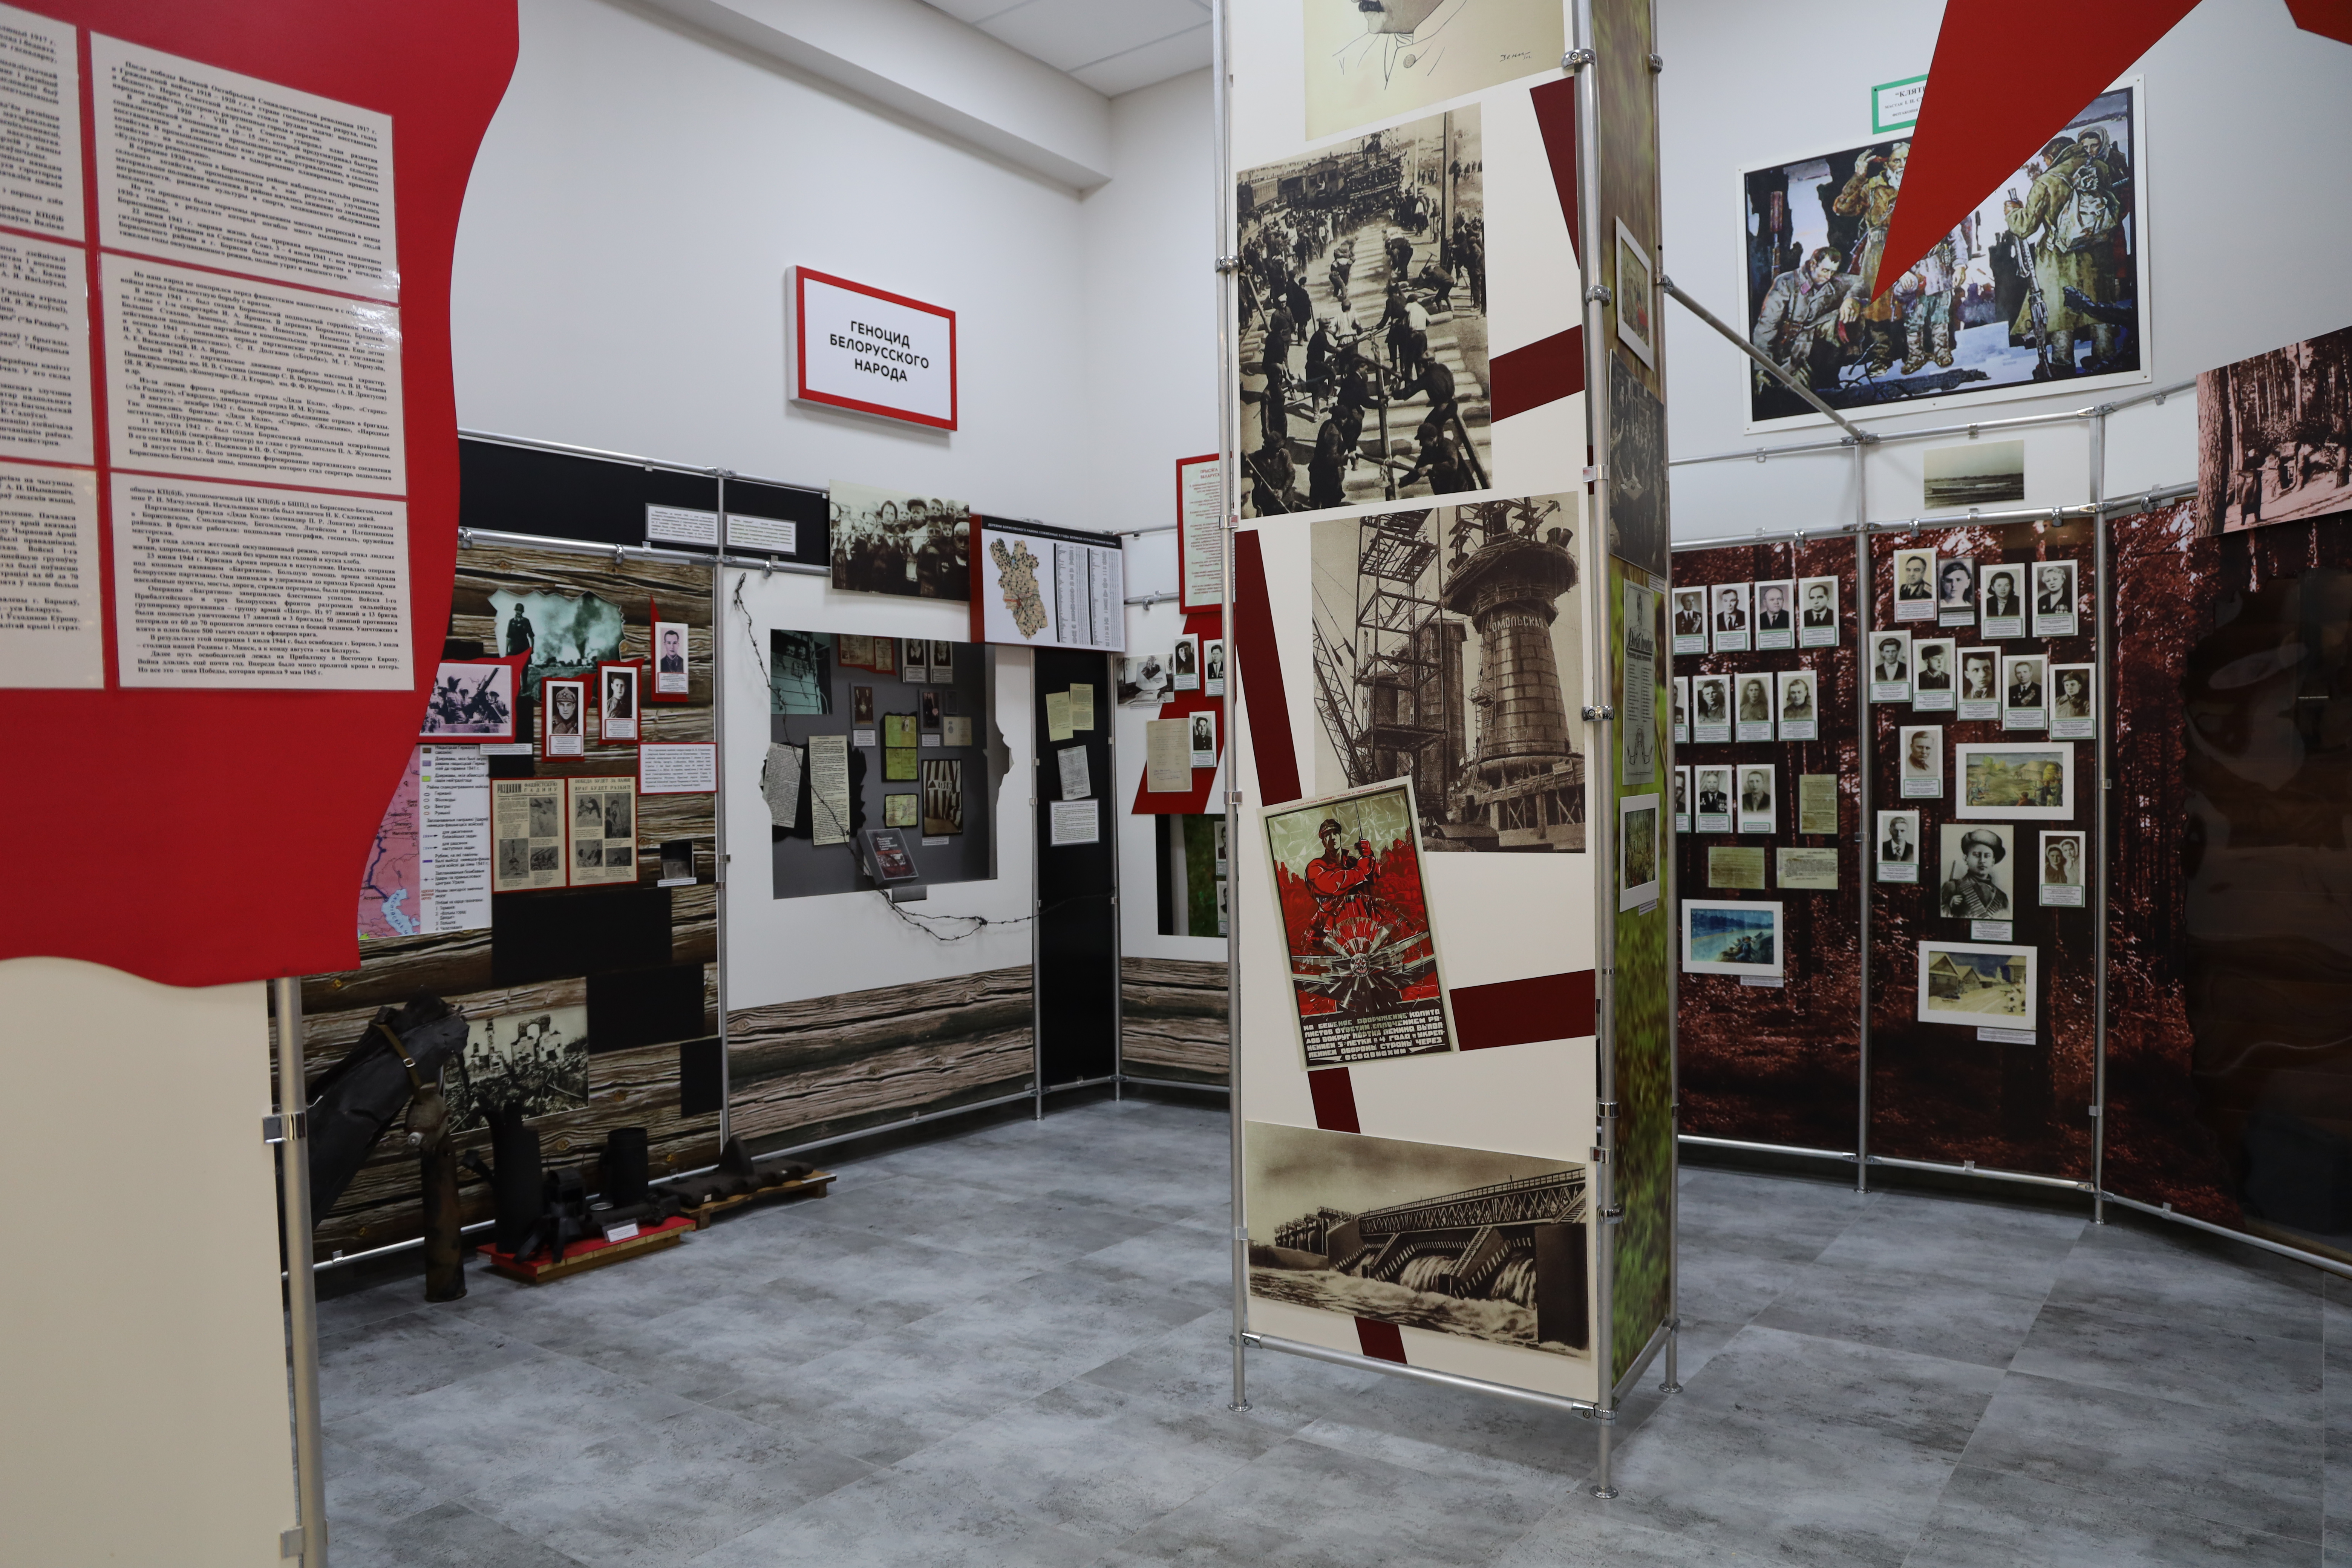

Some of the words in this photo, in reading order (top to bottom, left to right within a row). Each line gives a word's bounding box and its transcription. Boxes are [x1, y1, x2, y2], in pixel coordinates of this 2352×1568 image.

[125, 61, 147, 72] После
[150, 70, 176, 80] победы
[179, 76, 208, 89] Великой
[211, 86, 255, 101] Октябрьской
[258, 98, 317, 118] Социалистической
[320, 116, 354, 128] революции
[851, 320, 910, 349] ГЕНОЦИД
[830, 333, 929, 369] БЕЛОРУССКОГО
[854, 358, 907, 382] НАРОДА
[129, 449, 214, 462] Борисовско-Бегомльской
[185, 493, 243, 501] уполномоченный
[320, 504, 392, 515] Борисовско-Бегомльской
[1318, 1020, 1352, 1029] БЕШЕНОЕ
[1357, 1013, 1407, 1024] ВООРУЖЕНИЕ
[1409, 1009, 1440, 1018] КАПИТА
[1305, 1028, 1333, 1037] ЛИСТОВ
[1335, 1024, 1370, 1034] ОТВЕТИМ
[1322, 1033, 1351, 1042] ВОКРУГ
[1353, 1030, 1381, 1038] ПАРТИИ
[1383, 1026, 1415, 1035] ЛЕНИНА
[1307, 1042, 1335, 1050] НЕНИЕМ
[1309, 1049, 1337, 1057] ЛЕНИЕМ
[1341, 1044, 1377, 1054] ОБОРОНЫ
[1380, 1041, 1413, 1050] СТРАНЫ
[1415, 1037, 1442, 1046] ЧЕРЕЗ
[1345, 1048, 1406, 1061] ОСОАВИАХИМ
